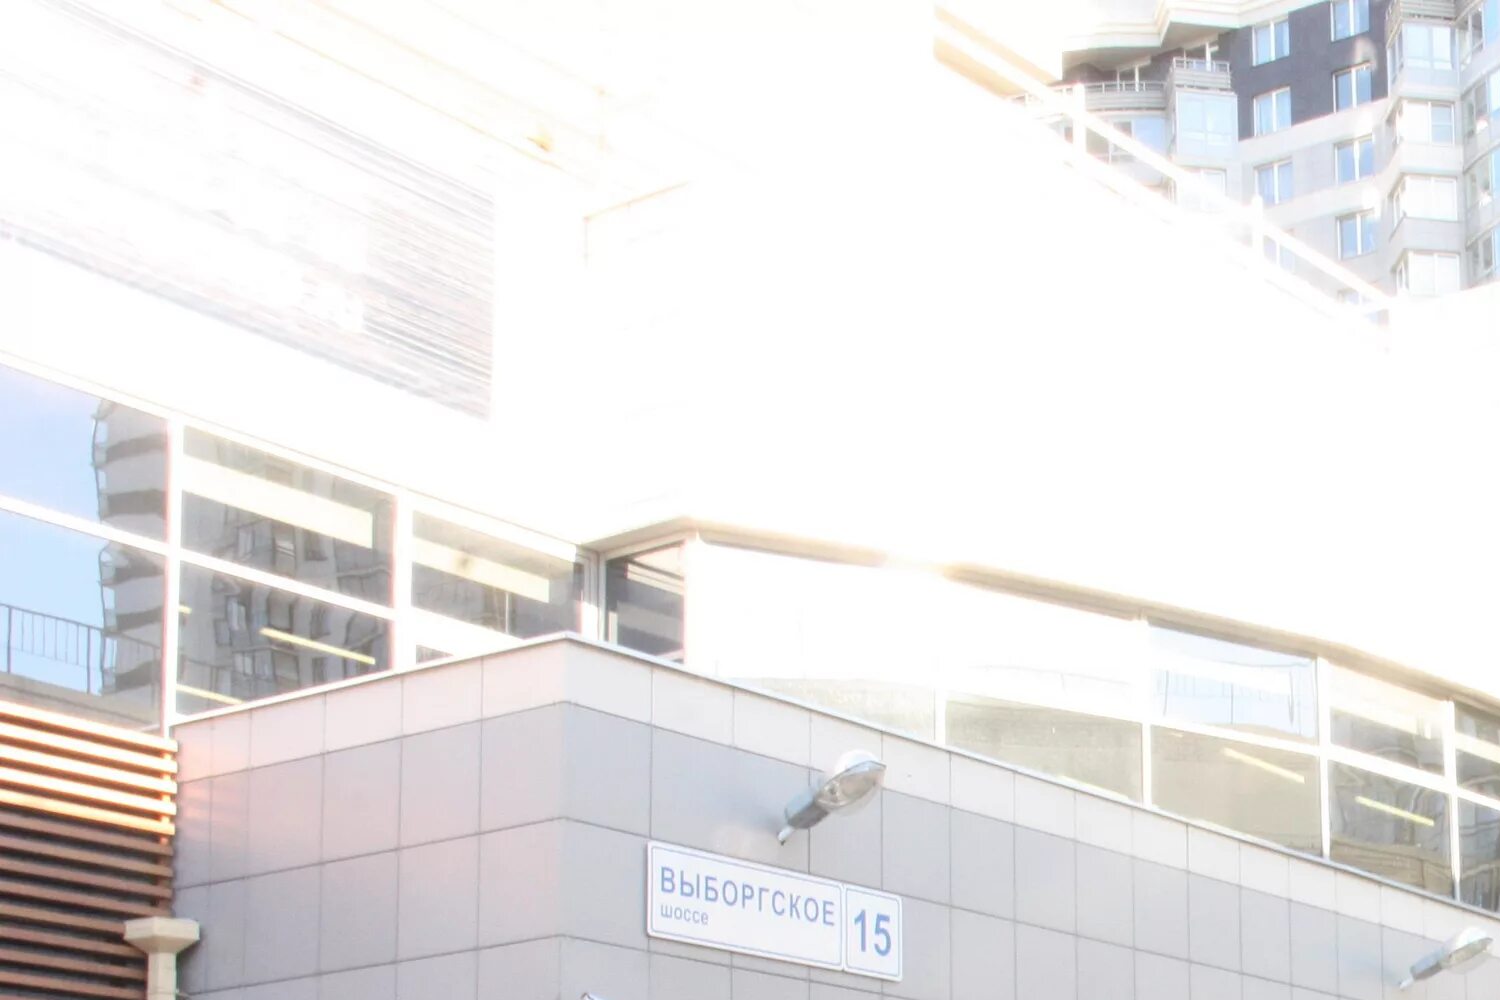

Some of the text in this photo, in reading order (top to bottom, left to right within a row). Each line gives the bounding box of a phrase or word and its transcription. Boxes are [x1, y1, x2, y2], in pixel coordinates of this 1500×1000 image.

[660, 866, 835, 926] ВЫБОРГСКОЕ
[660, 903, 709, 926] шоссе
[854, 908, 892, 957] 15
